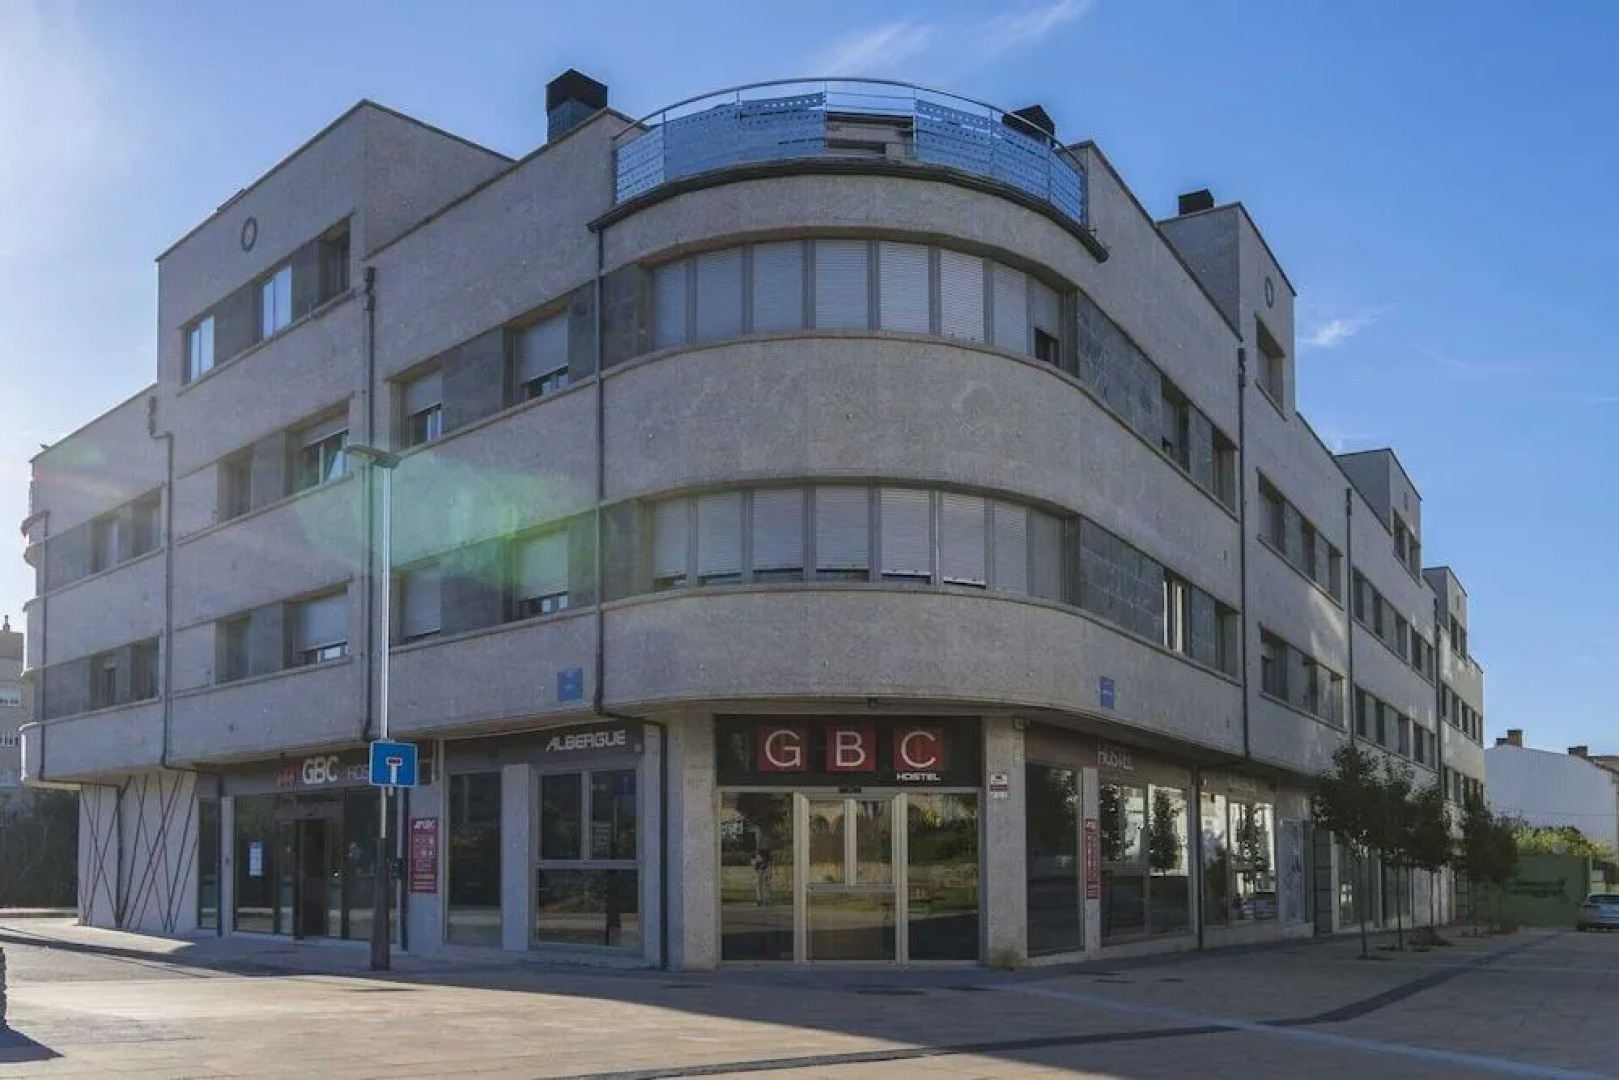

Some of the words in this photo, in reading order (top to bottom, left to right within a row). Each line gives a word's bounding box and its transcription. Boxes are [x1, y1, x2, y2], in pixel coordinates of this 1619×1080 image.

[545, 729, 626, 752] ALBERGUE
[302, 755, 339, 785] GBC
[896, 772, 941, 782] HOSTEL
